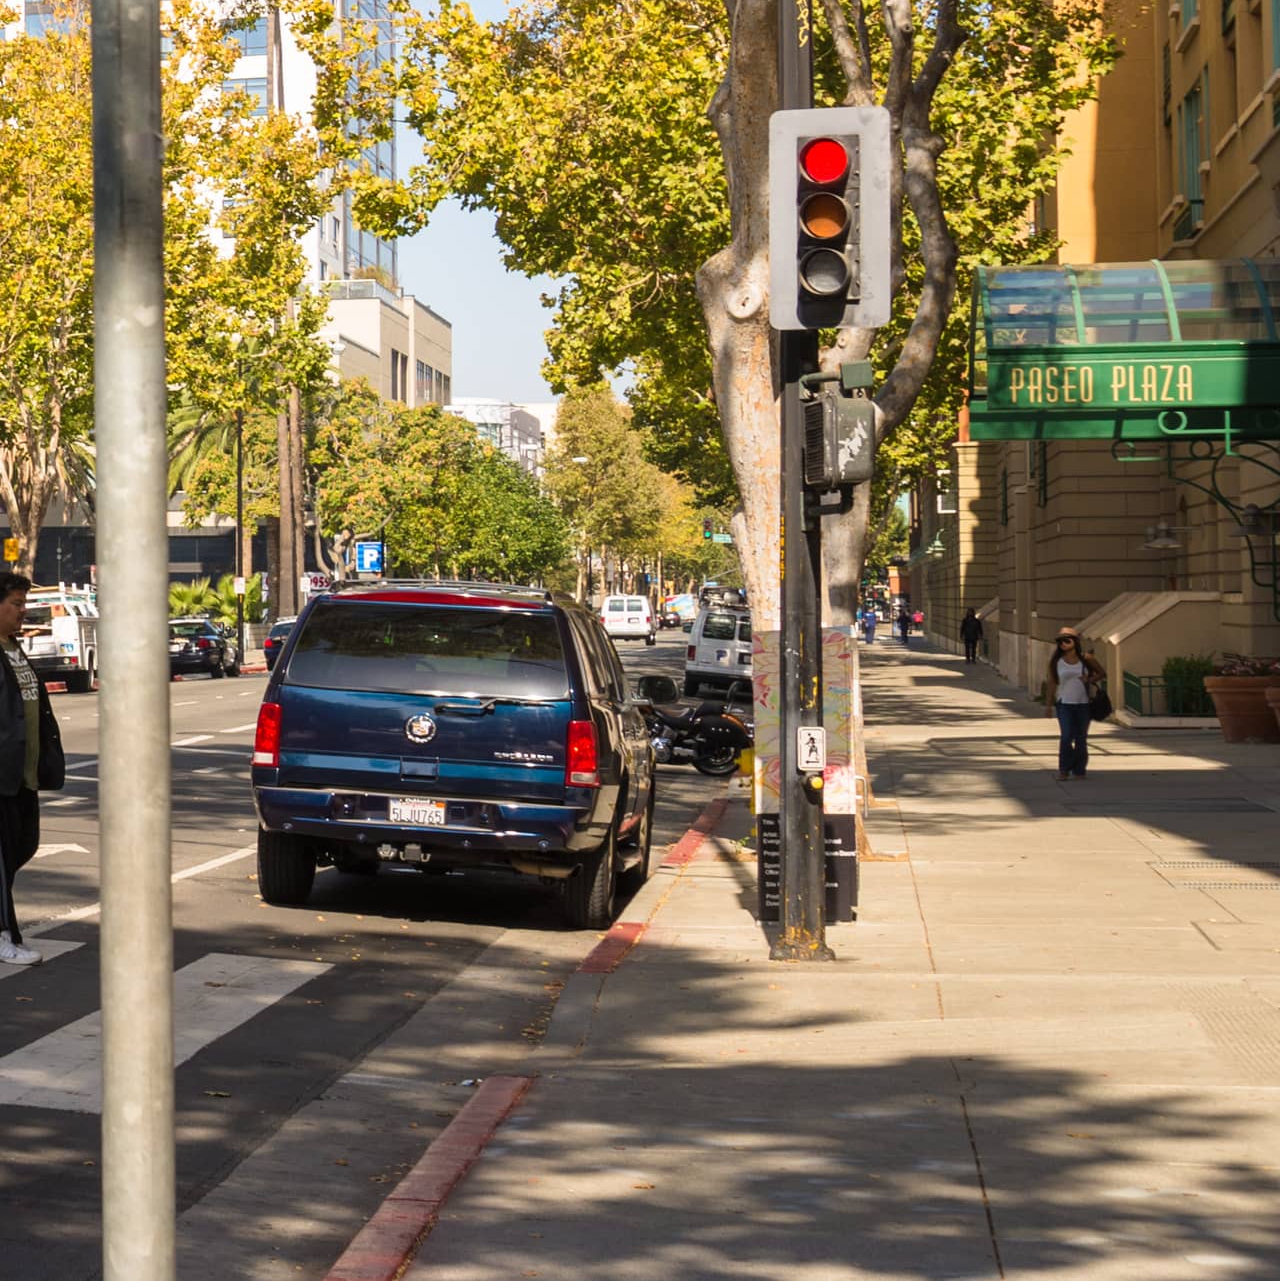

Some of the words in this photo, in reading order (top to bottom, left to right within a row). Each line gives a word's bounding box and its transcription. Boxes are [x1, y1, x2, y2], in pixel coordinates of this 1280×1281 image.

[1008, 366, 1094, 404] PASEO
[1111, 364, 1193, 402] PLAZA
[363, 549, 379, 569] P
